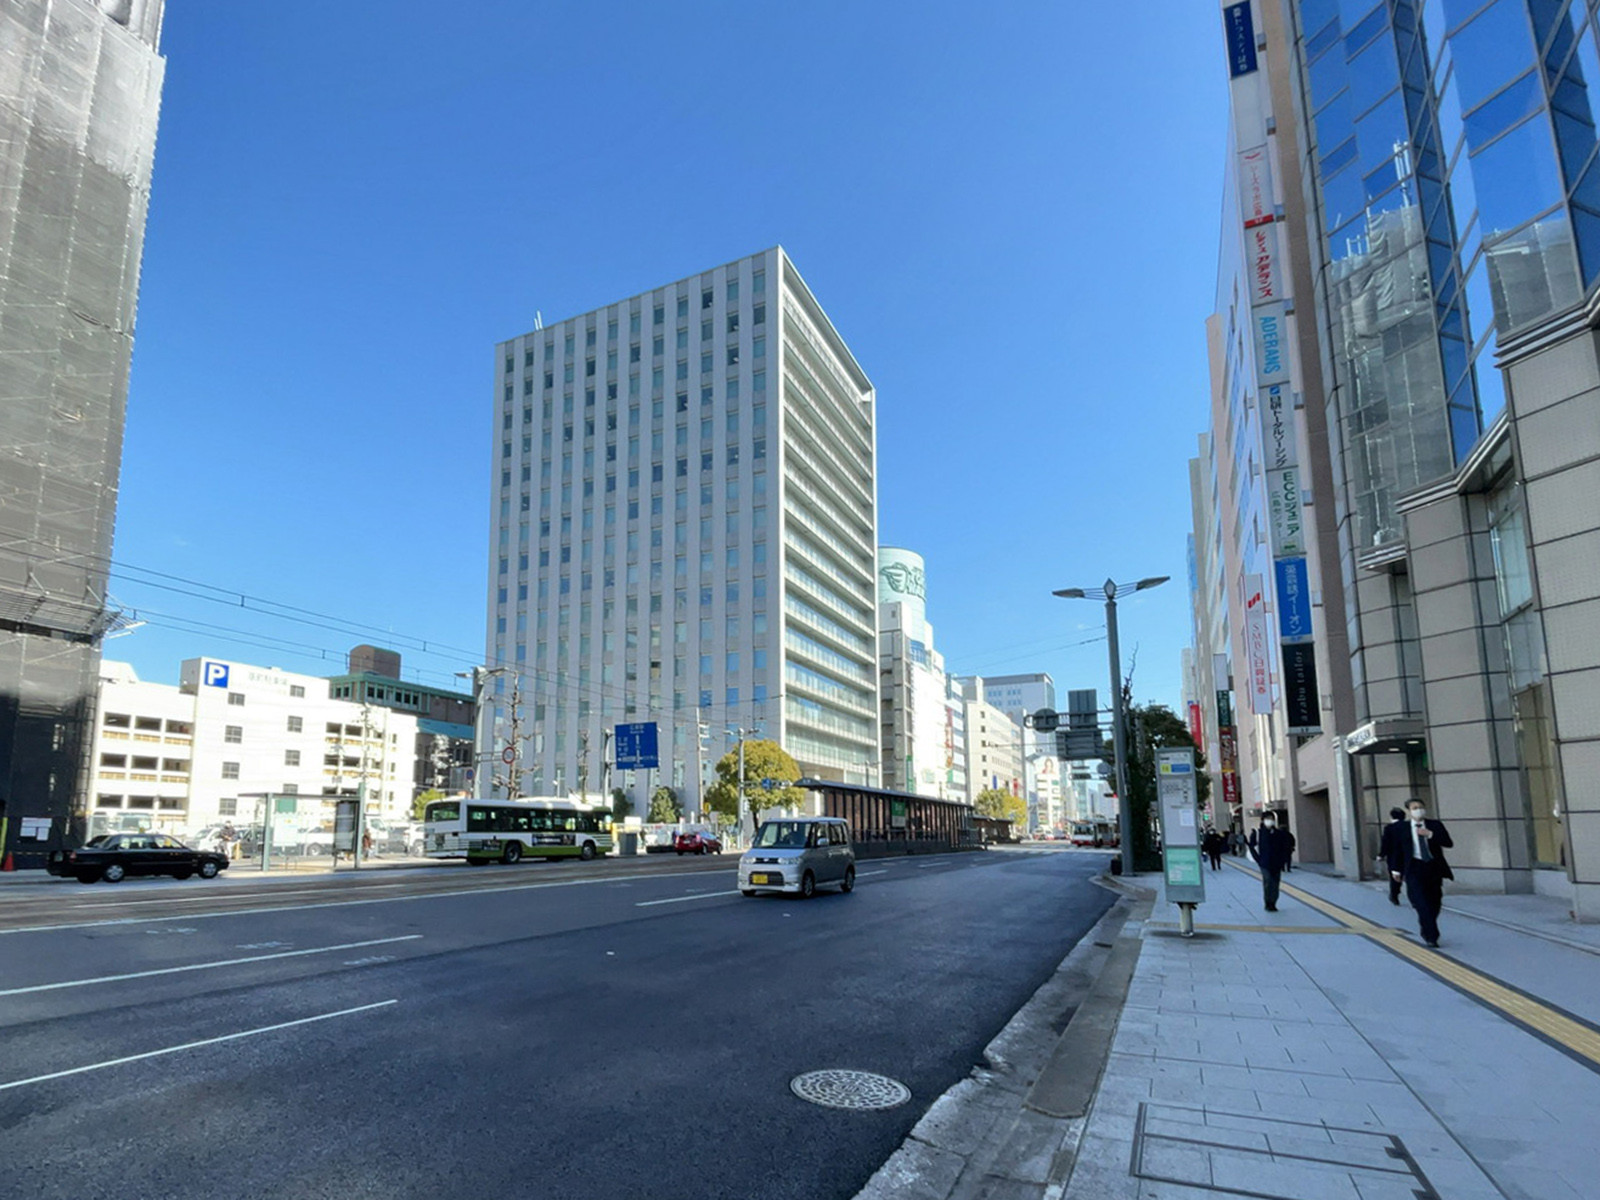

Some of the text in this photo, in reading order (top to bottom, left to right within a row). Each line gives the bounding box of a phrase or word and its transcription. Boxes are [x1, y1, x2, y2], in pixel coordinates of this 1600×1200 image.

[1259, 315, 1281, 375] ADERANS
[1269, 395, 1288, 468] 日研トータルソーシング
[1284, 564, 1303, 635] 英会話イーオン
[207, 664, 226, 685] P
[1293, 650, 1305, 684] tailor
[1296, 687, 1308, 722] azabu
